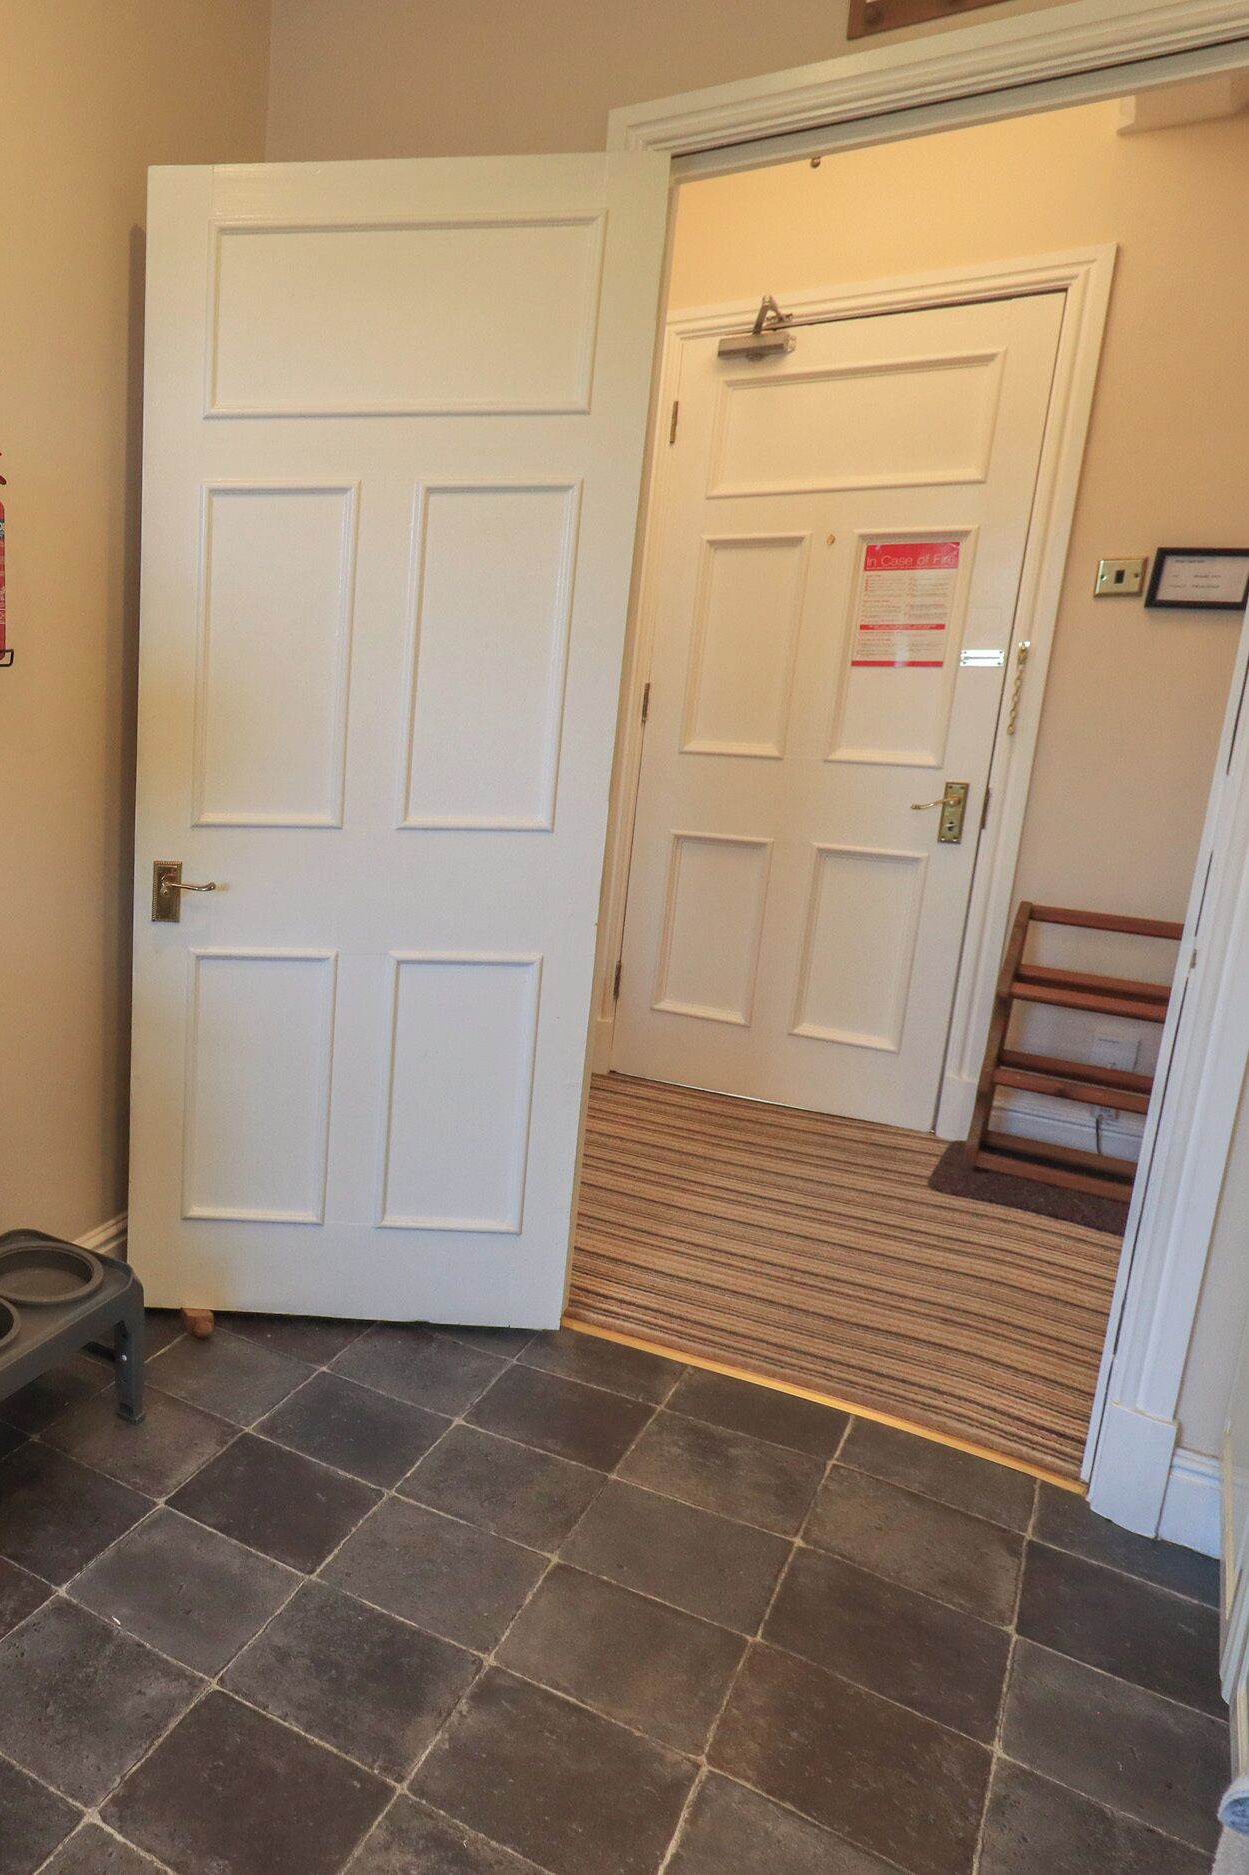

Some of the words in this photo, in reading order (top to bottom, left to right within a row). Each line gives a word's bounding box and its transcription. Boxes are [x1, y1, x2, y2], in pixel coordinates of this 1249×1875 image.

[866, 557, 877, 567] In
[880, 555, 913, 567] Case
[917, 553, 931, 566] of
